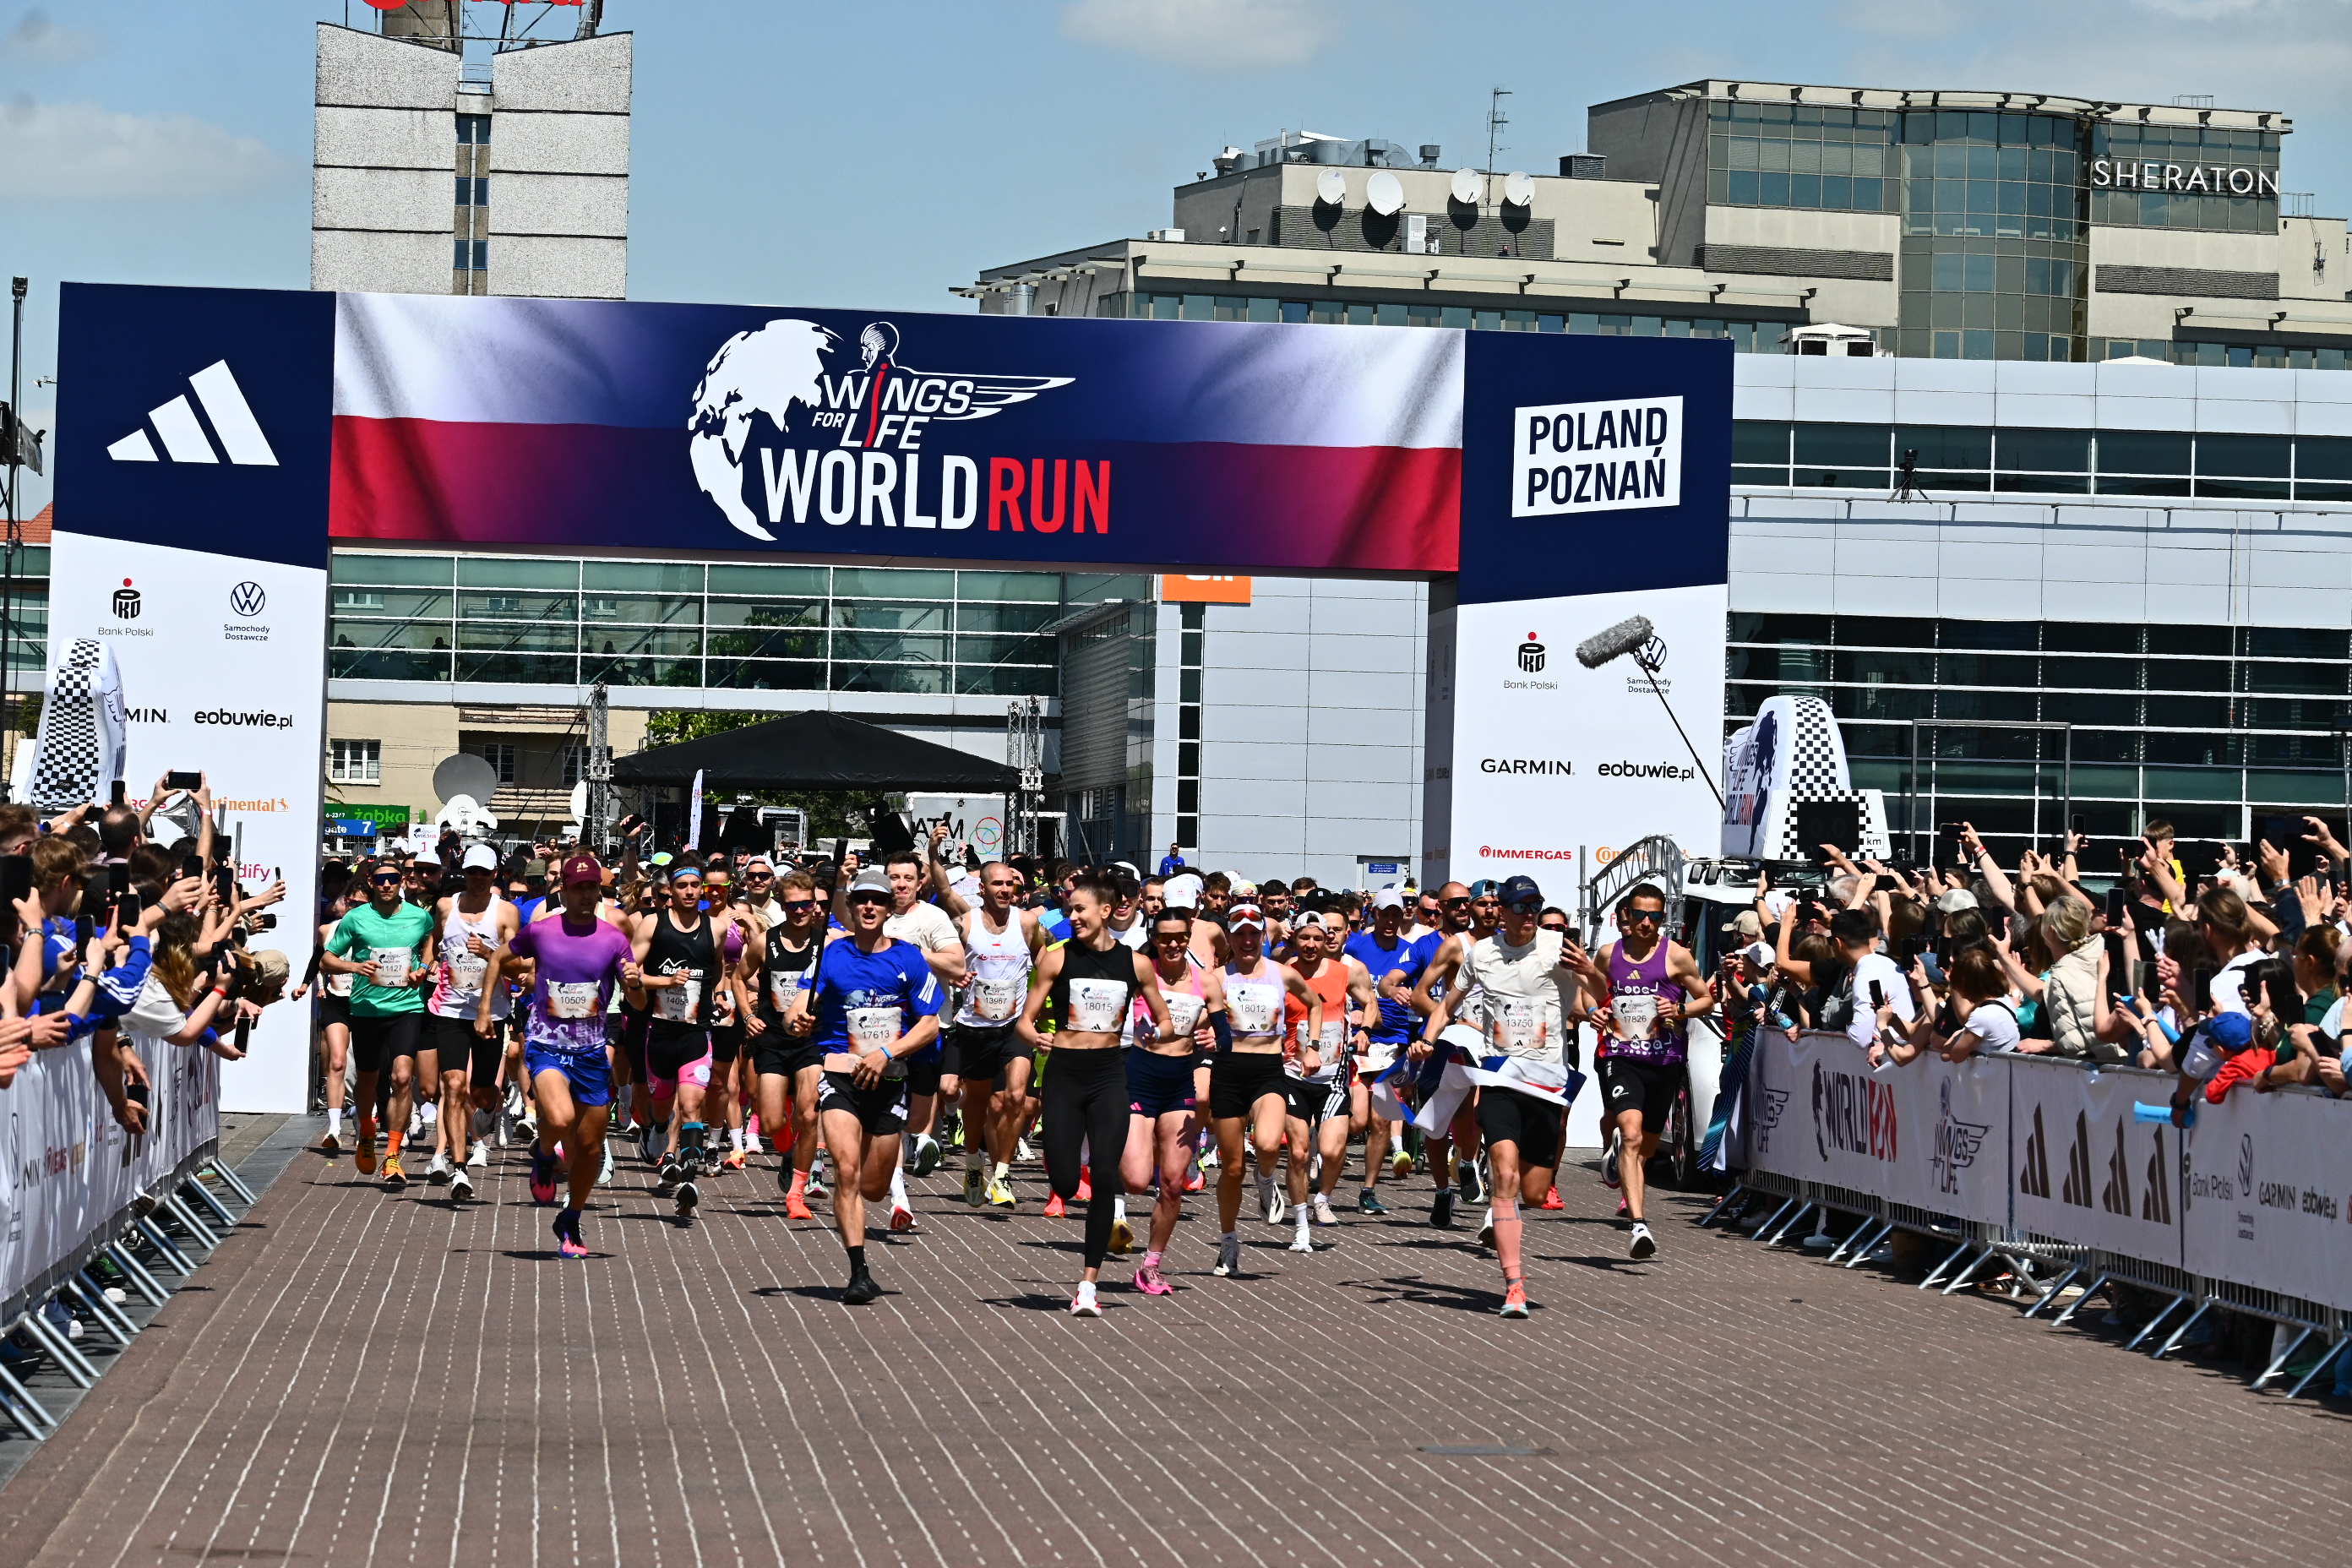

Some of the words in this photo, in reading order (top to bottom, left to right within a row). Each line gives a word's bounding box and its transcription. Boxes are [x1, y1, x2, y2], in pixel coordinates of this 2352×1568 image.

[2093, 160, 2279, 196] SHERATON
[812, 411, 845, 428] FOR
[840, 415, 931, 449] LIFE
[1528, 407, 1668, 455] POLAND
[1527, 446, 1666, 507] POZNAŃ
[760, 448, 978, 531] WORLD
[988, 457, 1111, 534] RUN
[98, 627, 122, 636] Bank
[125, 627, 154, 637] Polski
[224, 623, 270, 634] Samochody
[225, 633, 269, 641] Dostawcze
[1504, 680, 1528, 689] Bank
[1530, 681, 1558, 690] Polski
[1628, 685, 1670, 694] Dostawze
[124, 708, 166, 723] MIN
[194, 708, 293, 730] eobuwie.pl
[1480, 759, 1572, 776] GARMIN
[1598, 760, 1695, 781] eobuwie.pl
[324, 825, 347, 835] gate
[362, 820, 372, 834] 7
[1866, 837, 1881, 846] km
[1492, 848, 1572, 860] IMMERGAS
[560, 996, 586, 1004] 10509
[1084, 1002, 1113, 1012] 18015
[1239, 1004, 1266, 1013] 18012
[1506, 1019, 1533, 1027] 13750
[863, 1030, 890, 1039] 17613
[1823, 1070, 1868, 1155] WORLD
[2258, 1181, 2296, 1210] GARMIN
